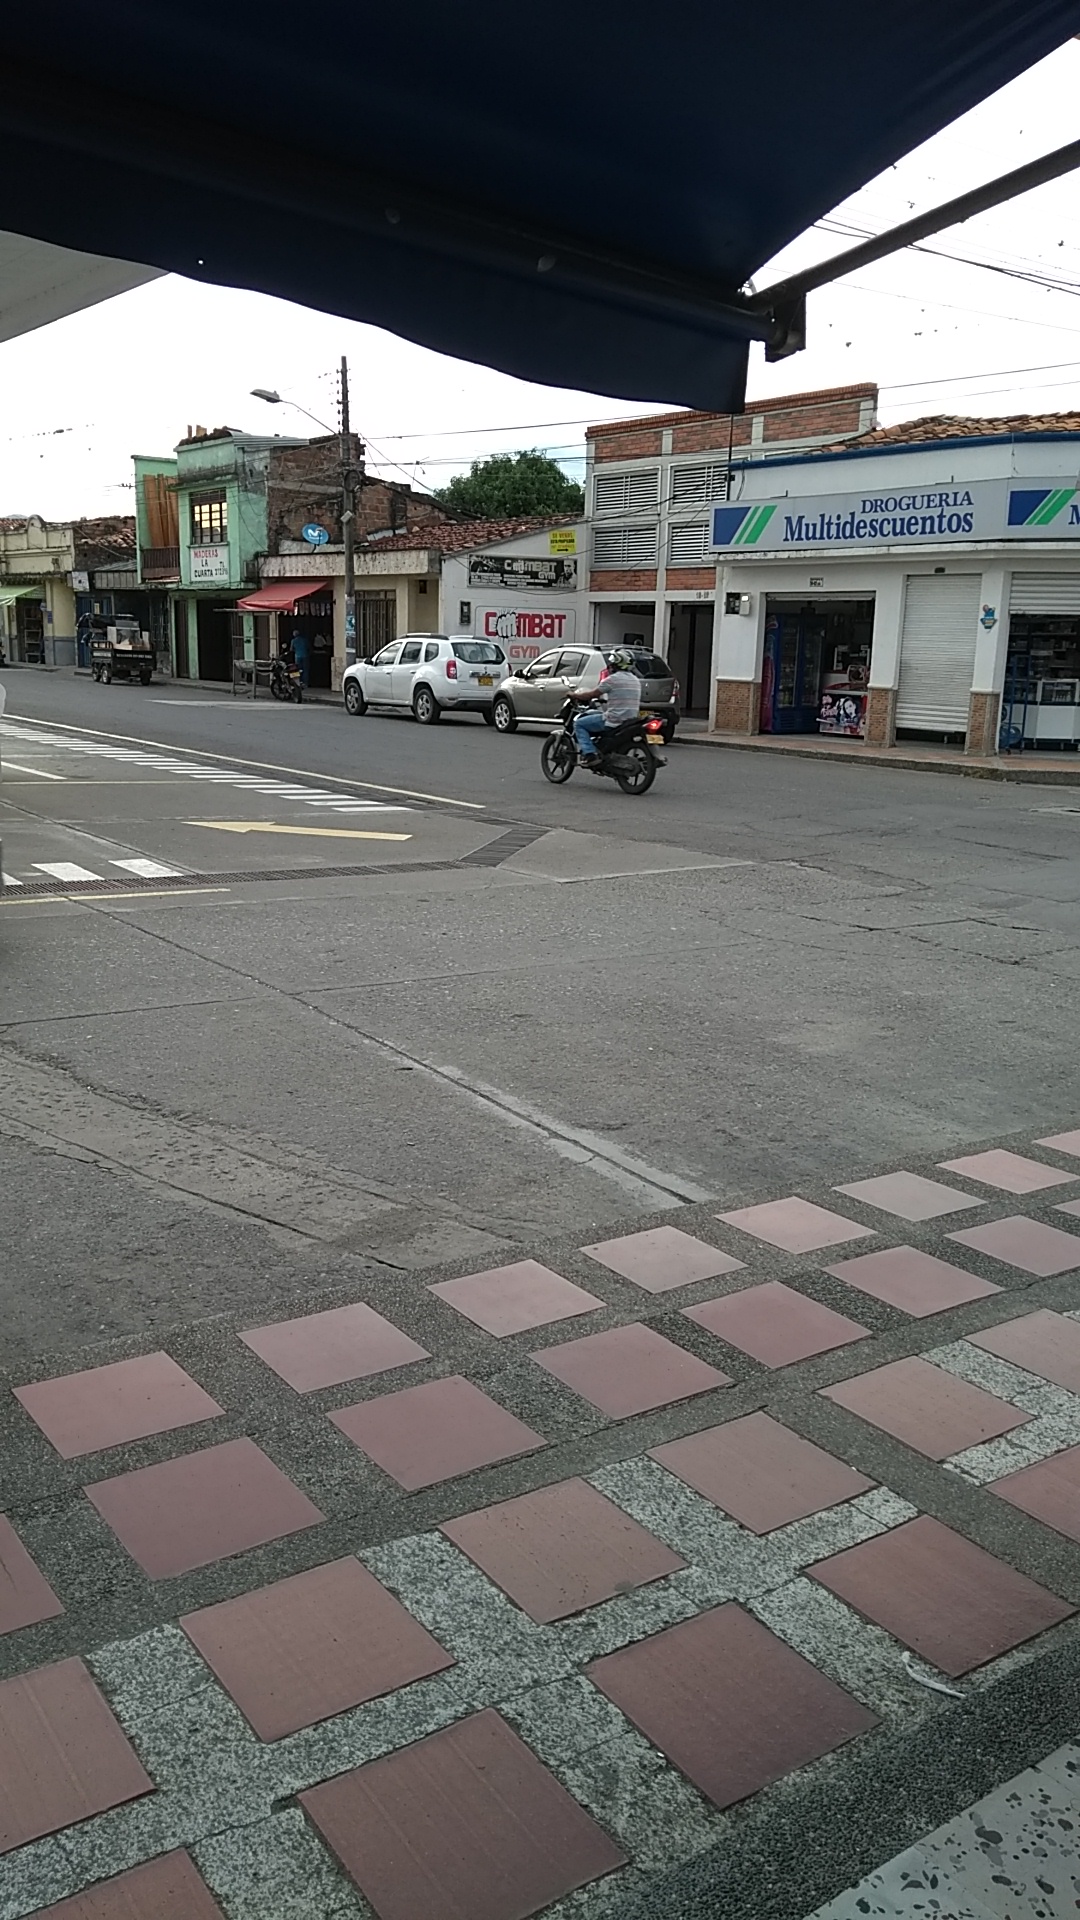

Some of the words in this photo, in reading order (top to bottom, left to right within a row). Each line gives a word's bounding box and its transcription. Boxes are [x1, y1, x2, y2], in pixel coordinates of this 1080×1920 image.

[860, 490, 975, 514] DROGUERIA
[782, 506, 975, 542] Multidescuentos
[194, 549, 218, 558] MADERAS
[201, 559, 208, 567] LA
[538, 571, 556, 580] GYM
[509, 645, 541, 659] GYM
